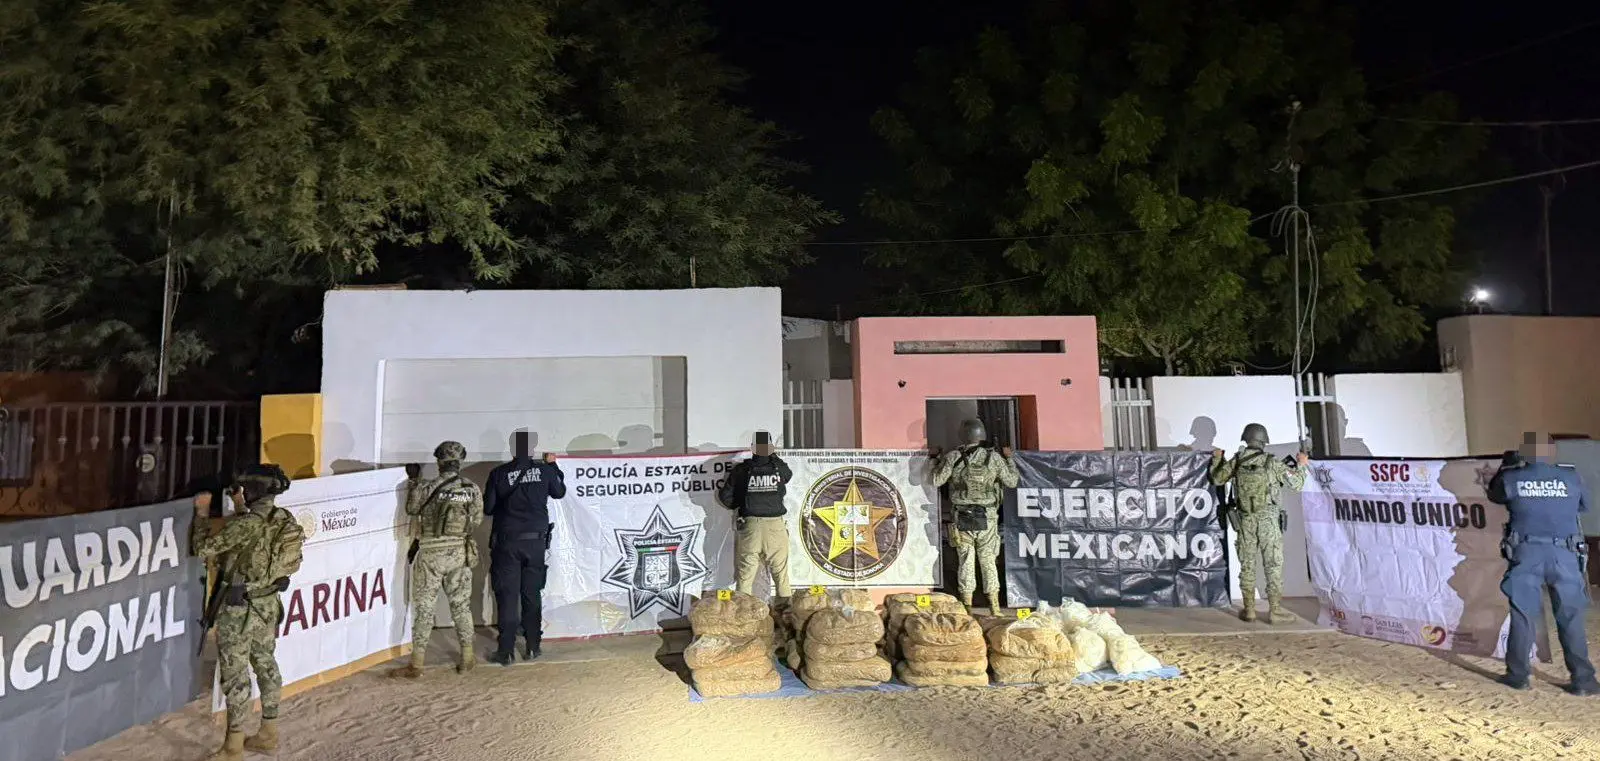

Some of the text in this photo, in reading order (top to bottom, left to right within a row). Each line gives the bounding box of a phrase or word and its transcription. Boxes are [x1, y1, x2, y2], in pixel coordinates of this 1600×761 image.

[576, 461, 733, 479] POLICÍA ESTATAL DE
[1370, 463, 1410, 482] SSPC
[576, 477, 725, 497] SEGURIDAD PÚBLIC
[1516, 479, 1567, 490] POLICÍA
[1518, 489, 1568, 498] MUNICIPAL
[1016, 480, 1214, 519] EJÉRCITO
[321, 509, 350, 518] Gobierno
[1334, 498, 1486, 529] MANDO ÚNICO
[322, 515, 357, 532] México
[1019, 532, 1216, 560] MEXICANO
[275, 568, 387, 638] ARINA
[0, 585, 185, 697] CIONAL
